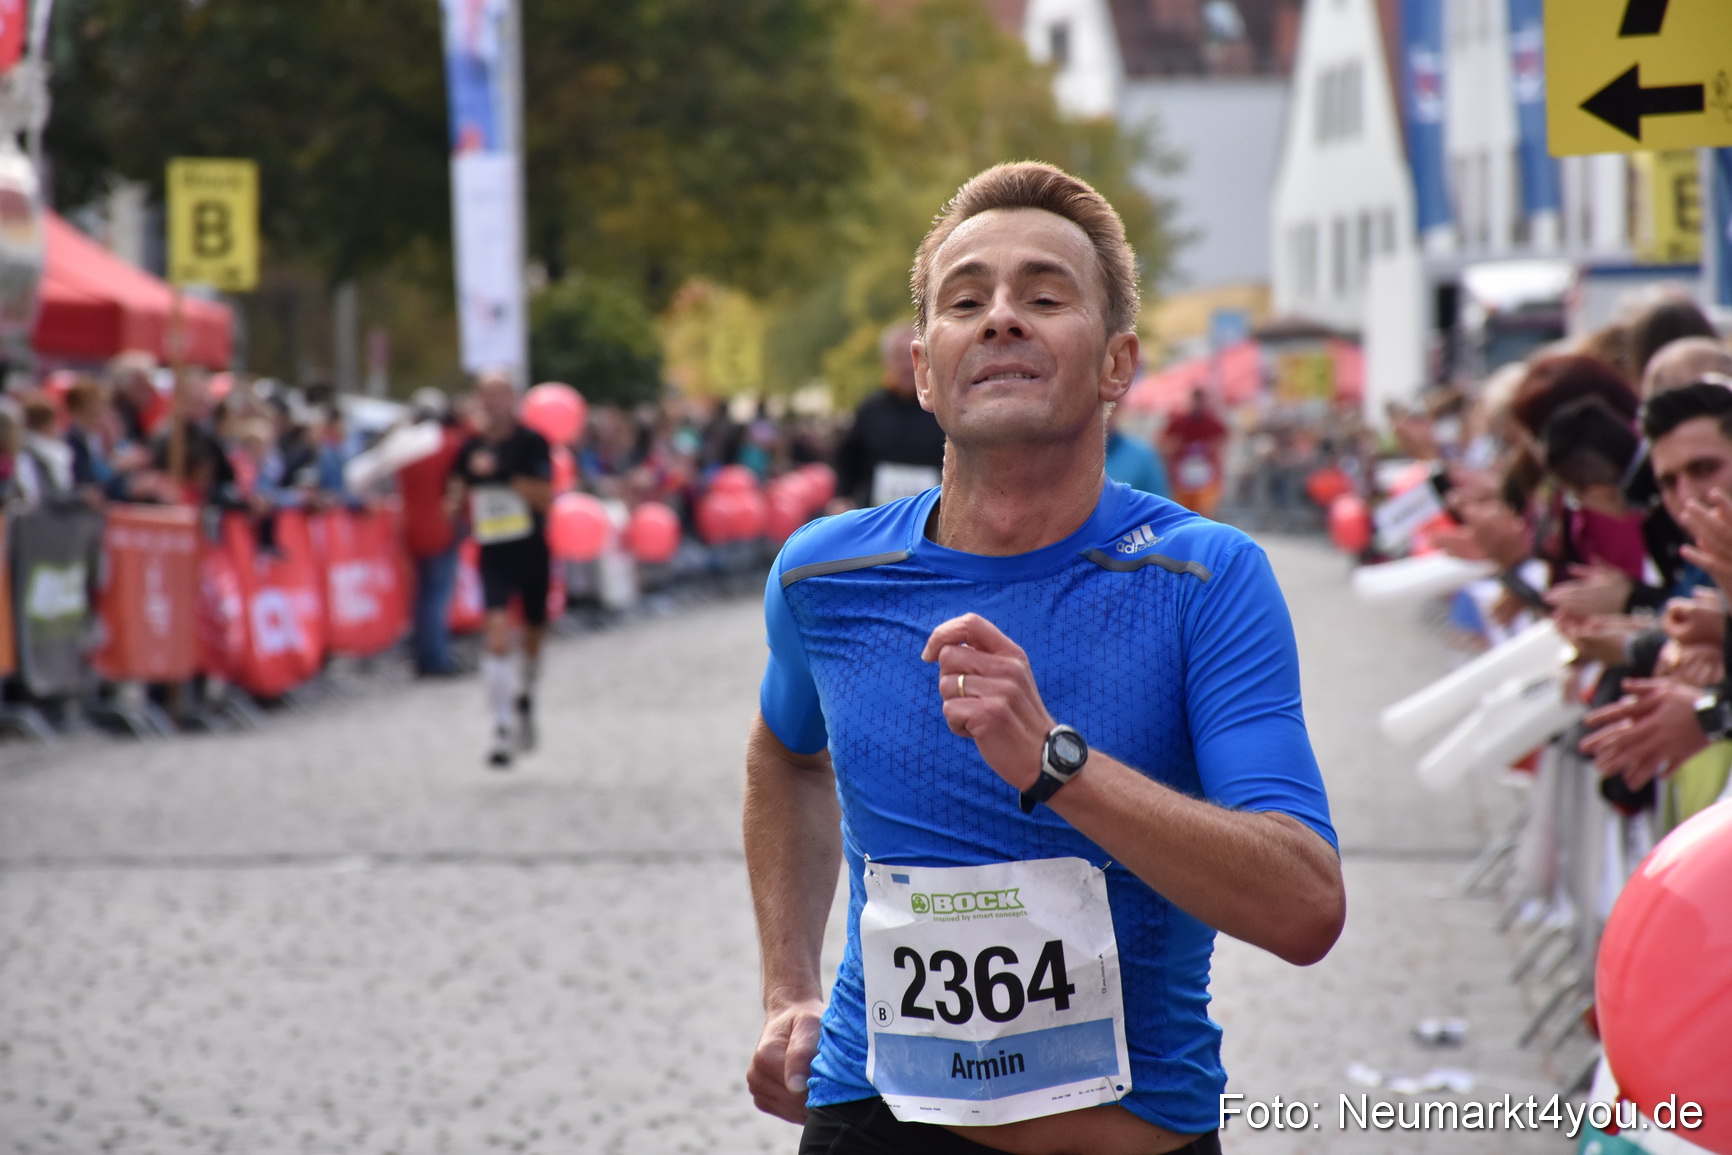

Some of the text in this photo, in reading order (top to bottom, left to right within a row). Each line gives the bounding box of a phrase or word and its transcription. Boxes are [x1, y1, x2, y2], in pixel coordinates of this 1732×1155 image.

[192, 199, 235, 259] B
[931, 889, 1024, 913] BOCK
[933, 910, 1028, 923] inspired by smart concepts
[893, 939, 1075, 1025] 2364
[878, 1007, 887, 1021] B
[951, 1050, 1025, 1080] Armin
